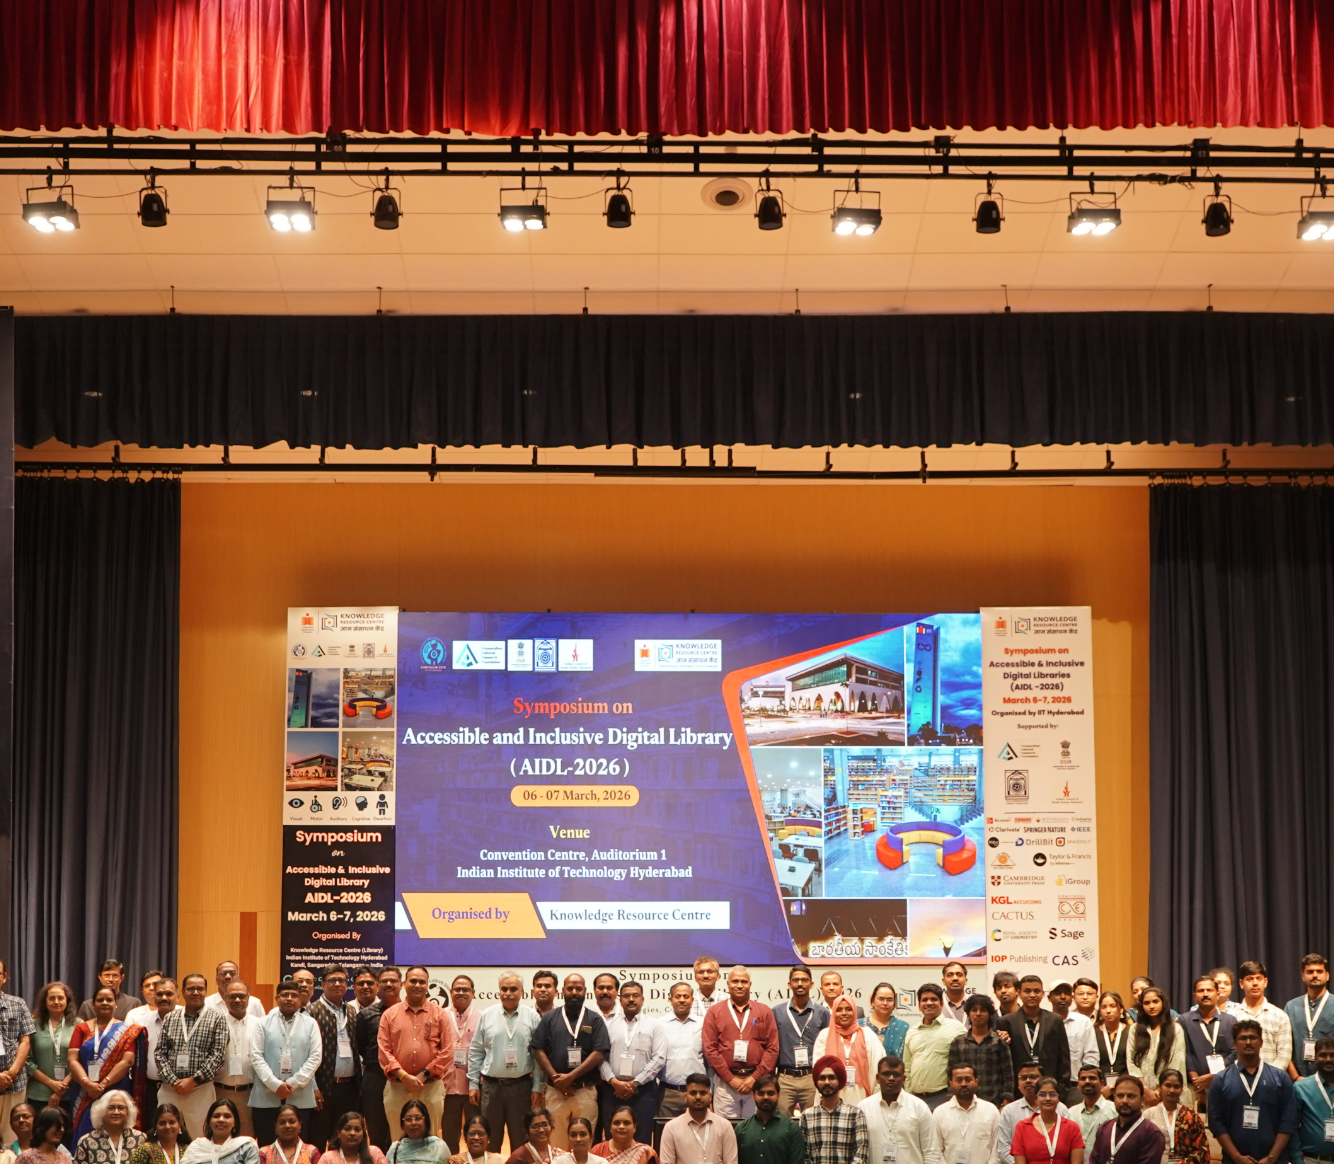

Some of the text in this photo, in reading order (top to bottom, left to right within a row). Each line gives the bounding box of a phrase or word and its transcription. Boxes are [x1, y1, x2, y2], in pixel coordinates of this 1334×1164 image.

[1004, 647, 1056, 656] Symposium
[1003, 672, 1031, 681] Digital
[513, 698, 633, 718] Symposium on
[403, 727, 733, 750] Accessible and Inclusive Digital Library
[523, 790, 630, 802] 06 07 March, 2026
[296, 830, 381, 845] Symposium
[549, 826, 590, 838] Venue
[480, 849, 667, 862] Convention Centre, Auditorium 1
[286, 865, 336, 873] Accessible
[349, 865, 390, 873] Inclusive
[457, 866, 692, 880] Indian Institute of Technology Hyderabad
[305, 877, 369, 888] Digital Library
[305, 892, 372, 903] AIDL-2026
[991, 896, 1012, 904] KGL
[288, 911, 385, 922] March 6-7, 2026
[432, 907, 509, 923] Organised by
[551, 909, 711, 923] Knowledge Resource Centre
[312, 931, 361, 941] Organised By
[1061, 929, 1084, 939] Sage
[1010, 955, 1048, 964] Publishing
[1052, 955, 1078, 965] CAS
